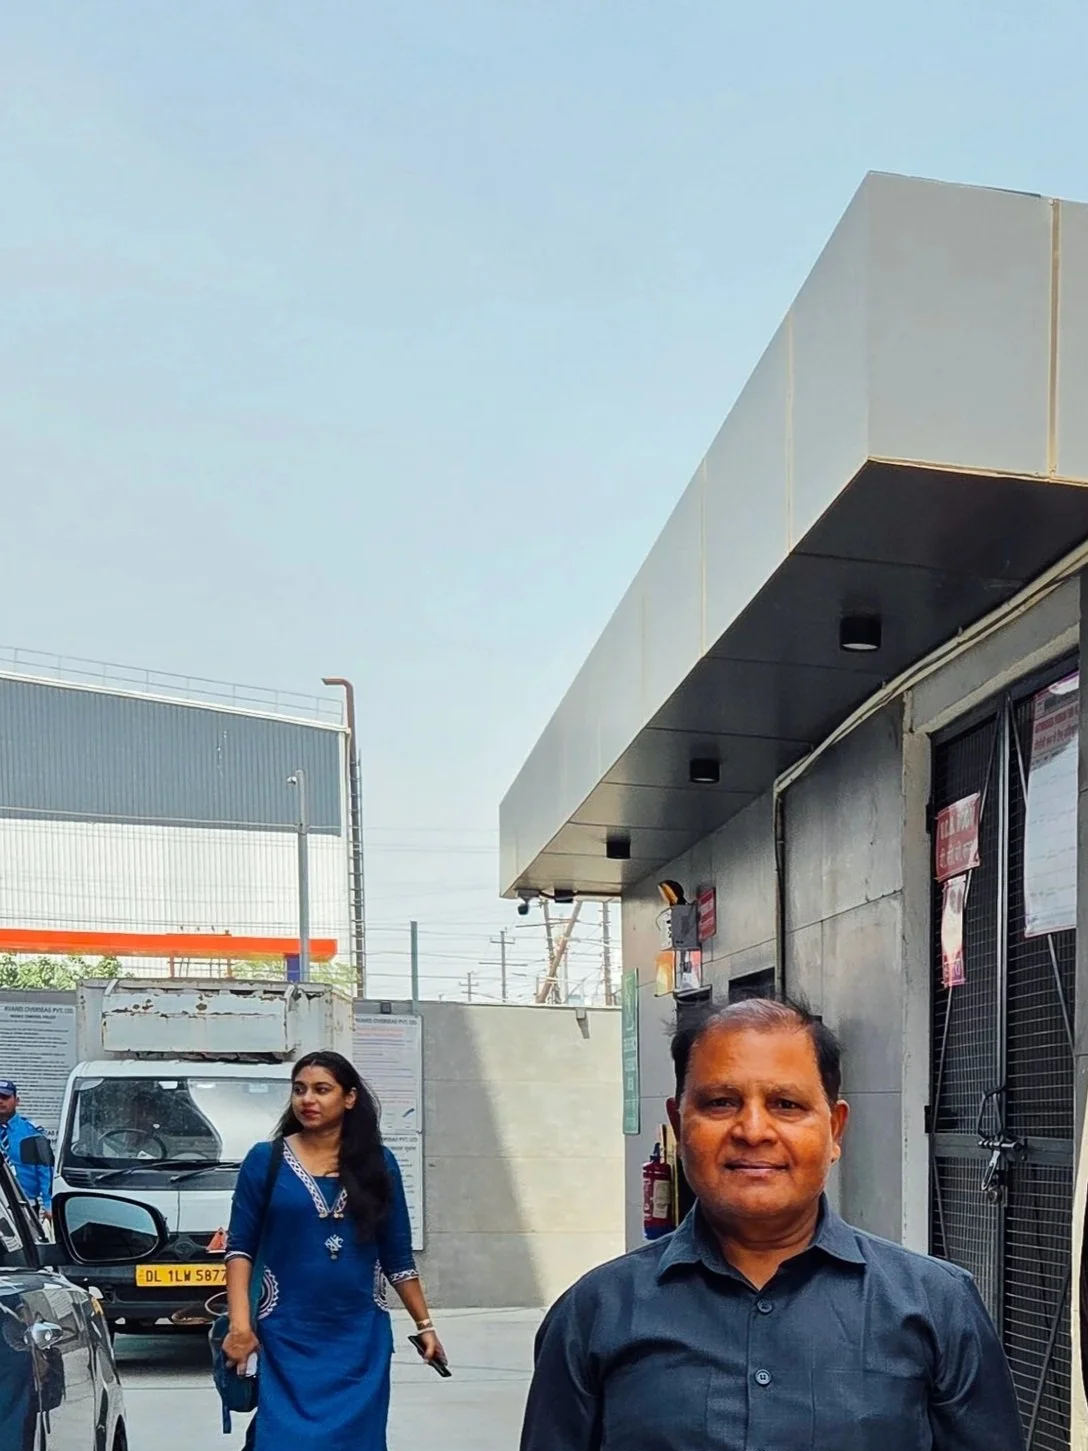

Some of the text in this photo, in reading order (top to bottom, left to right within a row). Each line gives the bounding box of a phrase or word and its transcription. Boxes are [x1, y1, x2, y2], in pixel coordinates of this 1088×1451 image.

[146, 1269, 226, 1283] DL 1LW 5877
